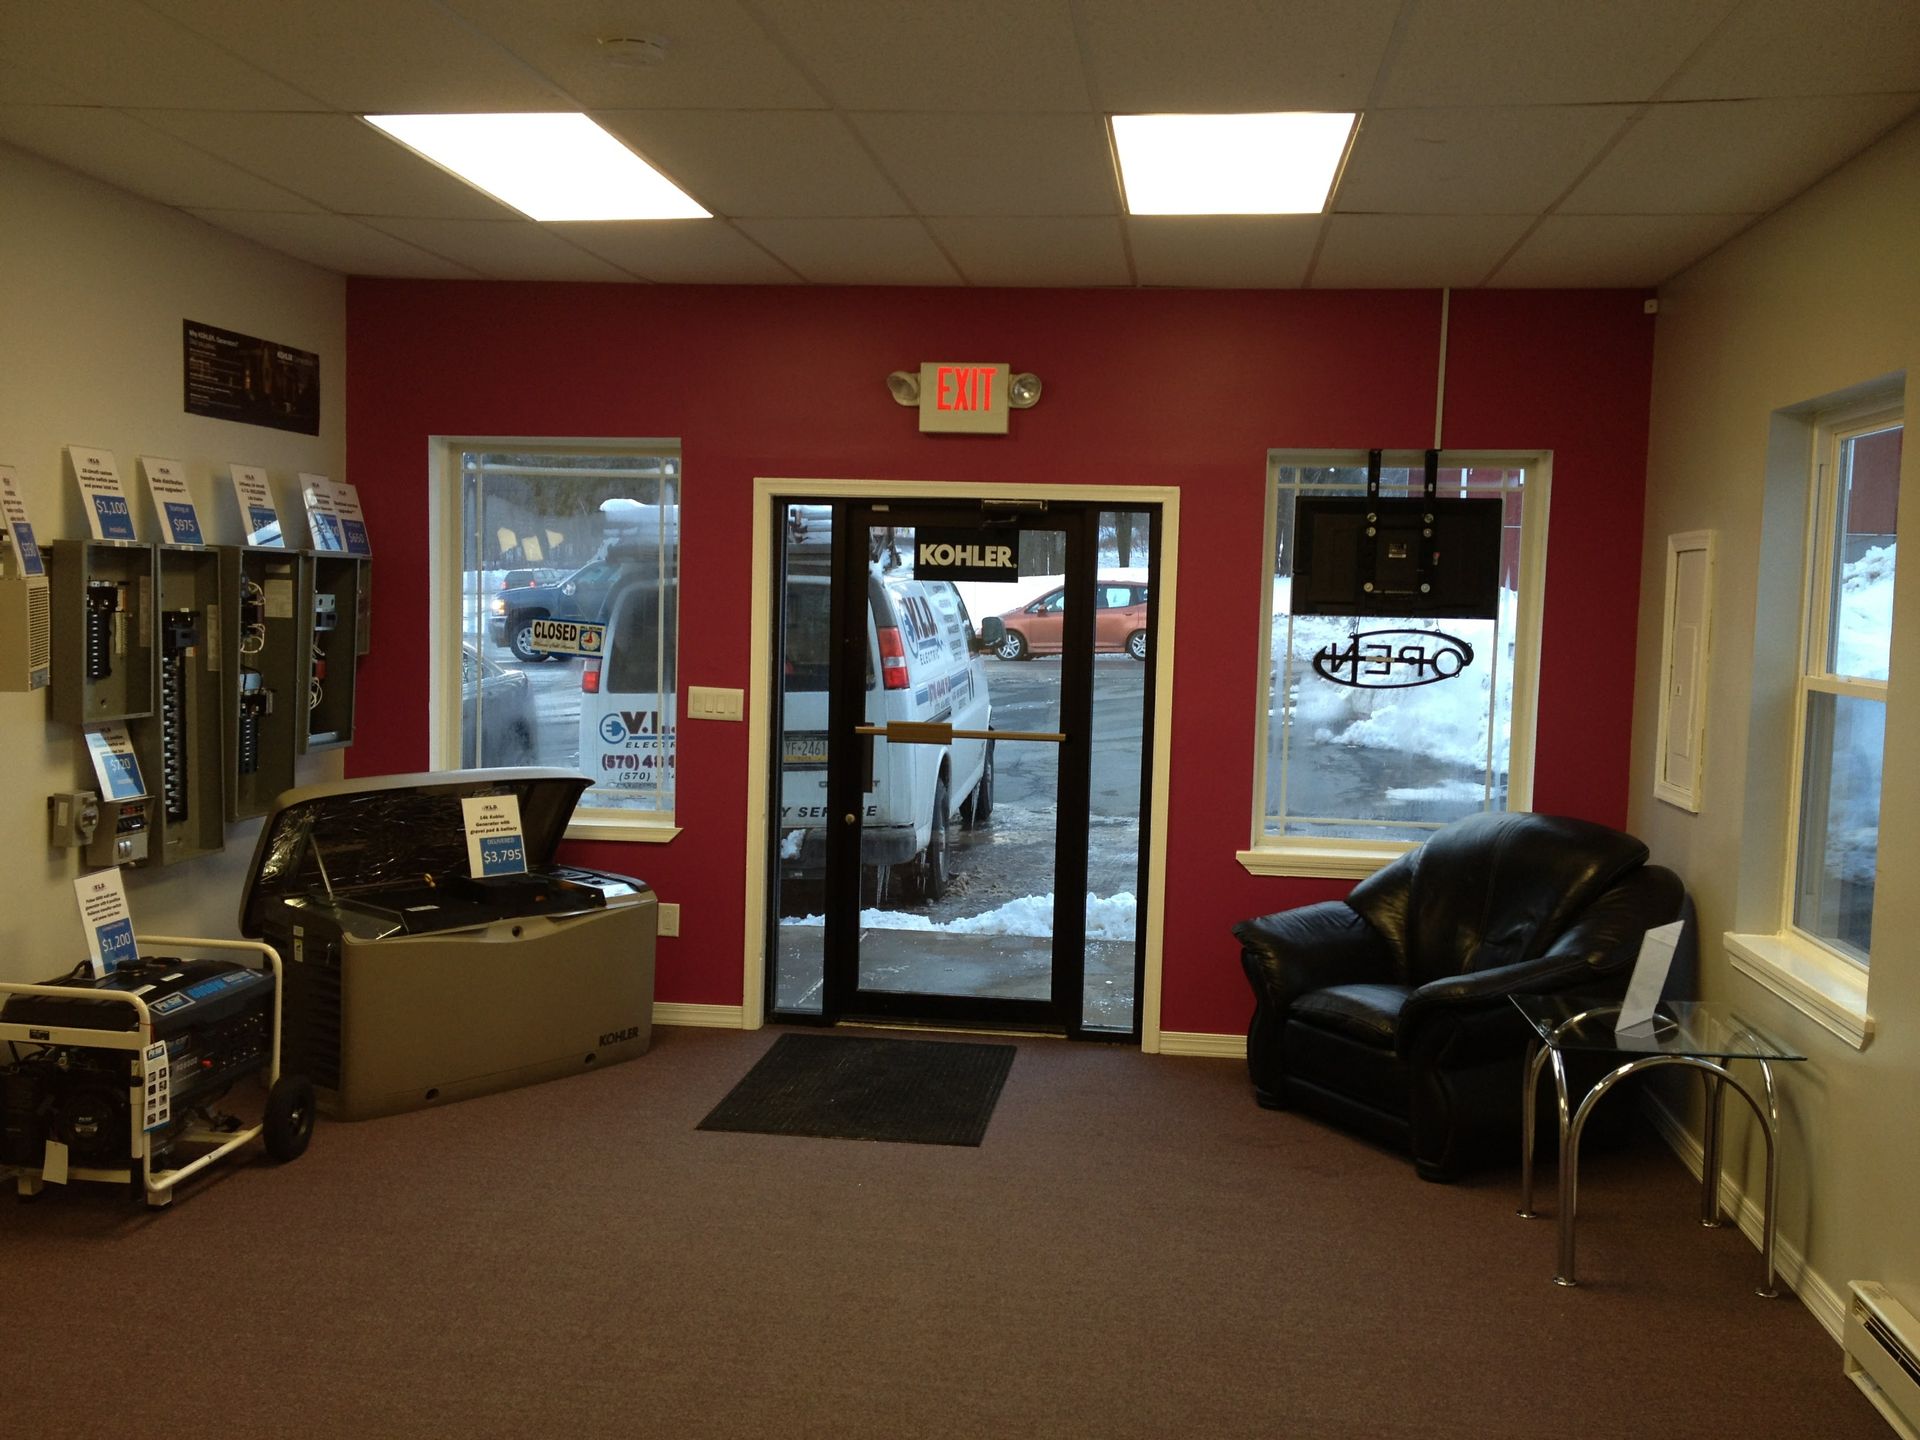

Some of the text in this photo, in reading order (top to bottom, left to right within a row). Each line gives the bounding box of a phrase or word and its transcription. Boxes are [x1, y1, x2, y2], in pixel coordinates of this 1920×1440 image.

[937, 367, 998, 412] EXIT
[96, 499, 127, 515] $1,100
[173, 518, 195, 532] $975
[920, 543, 1013, 568] KOHLER
[534, 621, 577, 642] CLOSED
[111, 758, 131, 773] $720
[602, 753, 640, 771] (570)
[619, 771, 651, 781] (570)
[483, 848, 522, 864] $3,795
[102, 932, 131, 953] $1,200
[599, 1026, 639, 1047] KOHLER
